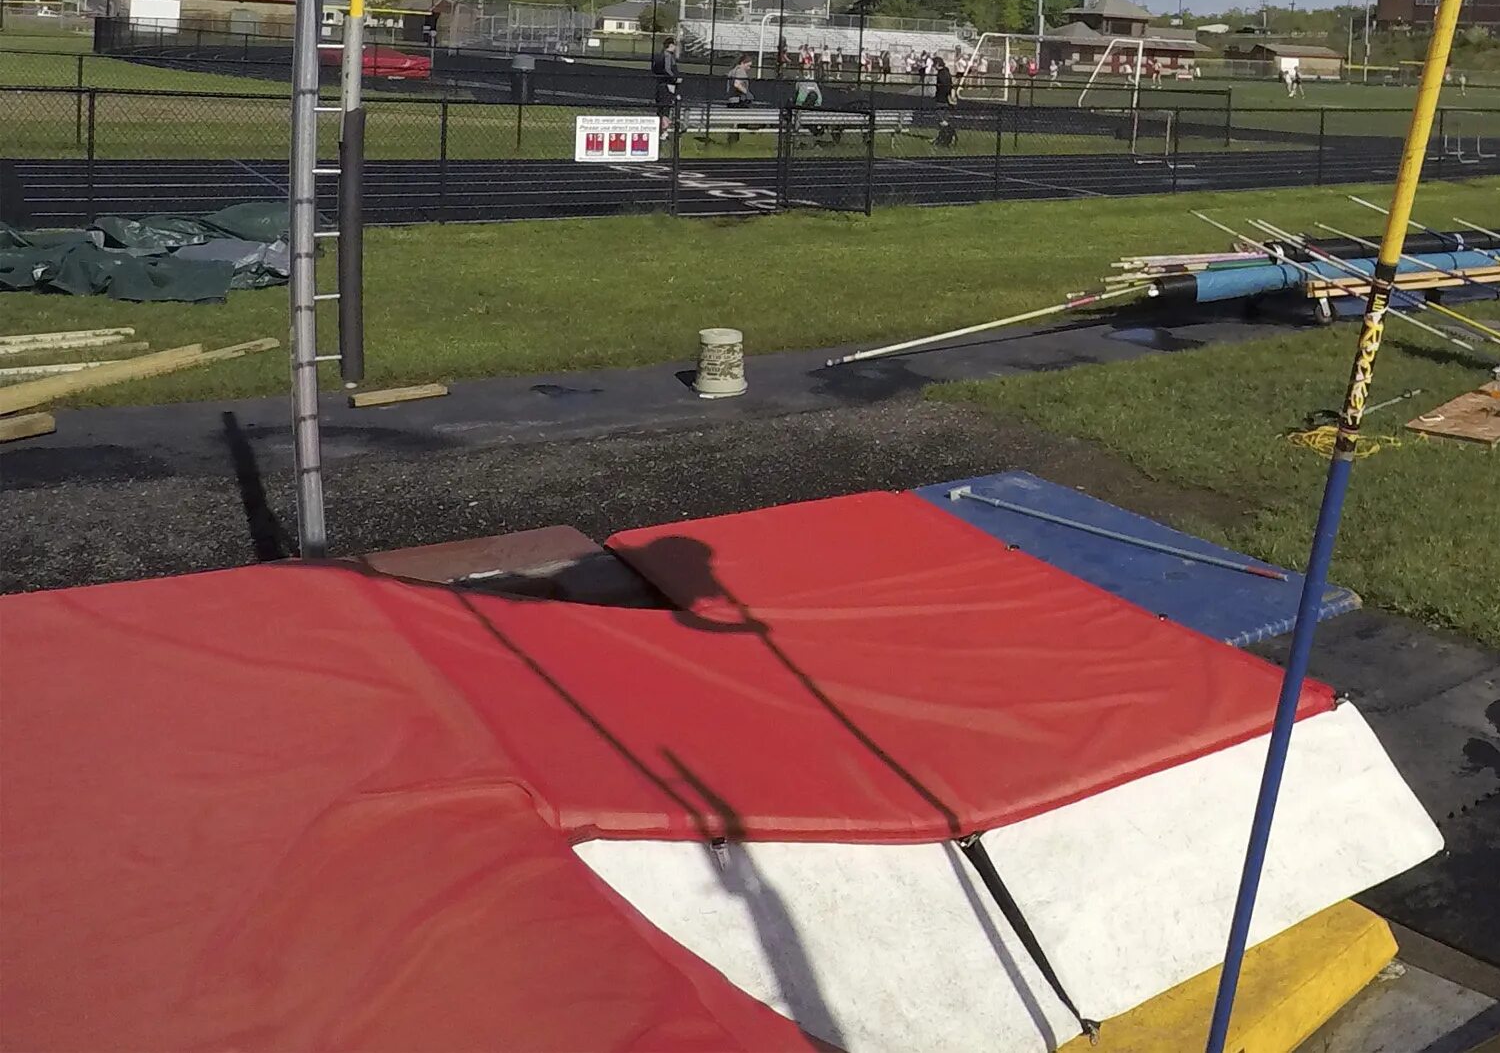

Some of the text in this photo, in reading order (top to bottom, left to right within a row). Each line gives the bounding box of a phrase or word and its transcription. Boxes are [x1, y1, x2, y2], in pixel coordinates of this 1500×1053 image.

[597, 134, 603, 142] 2
[610, 134, 616, 142] 3
[620, 134, 626, 142] 4
